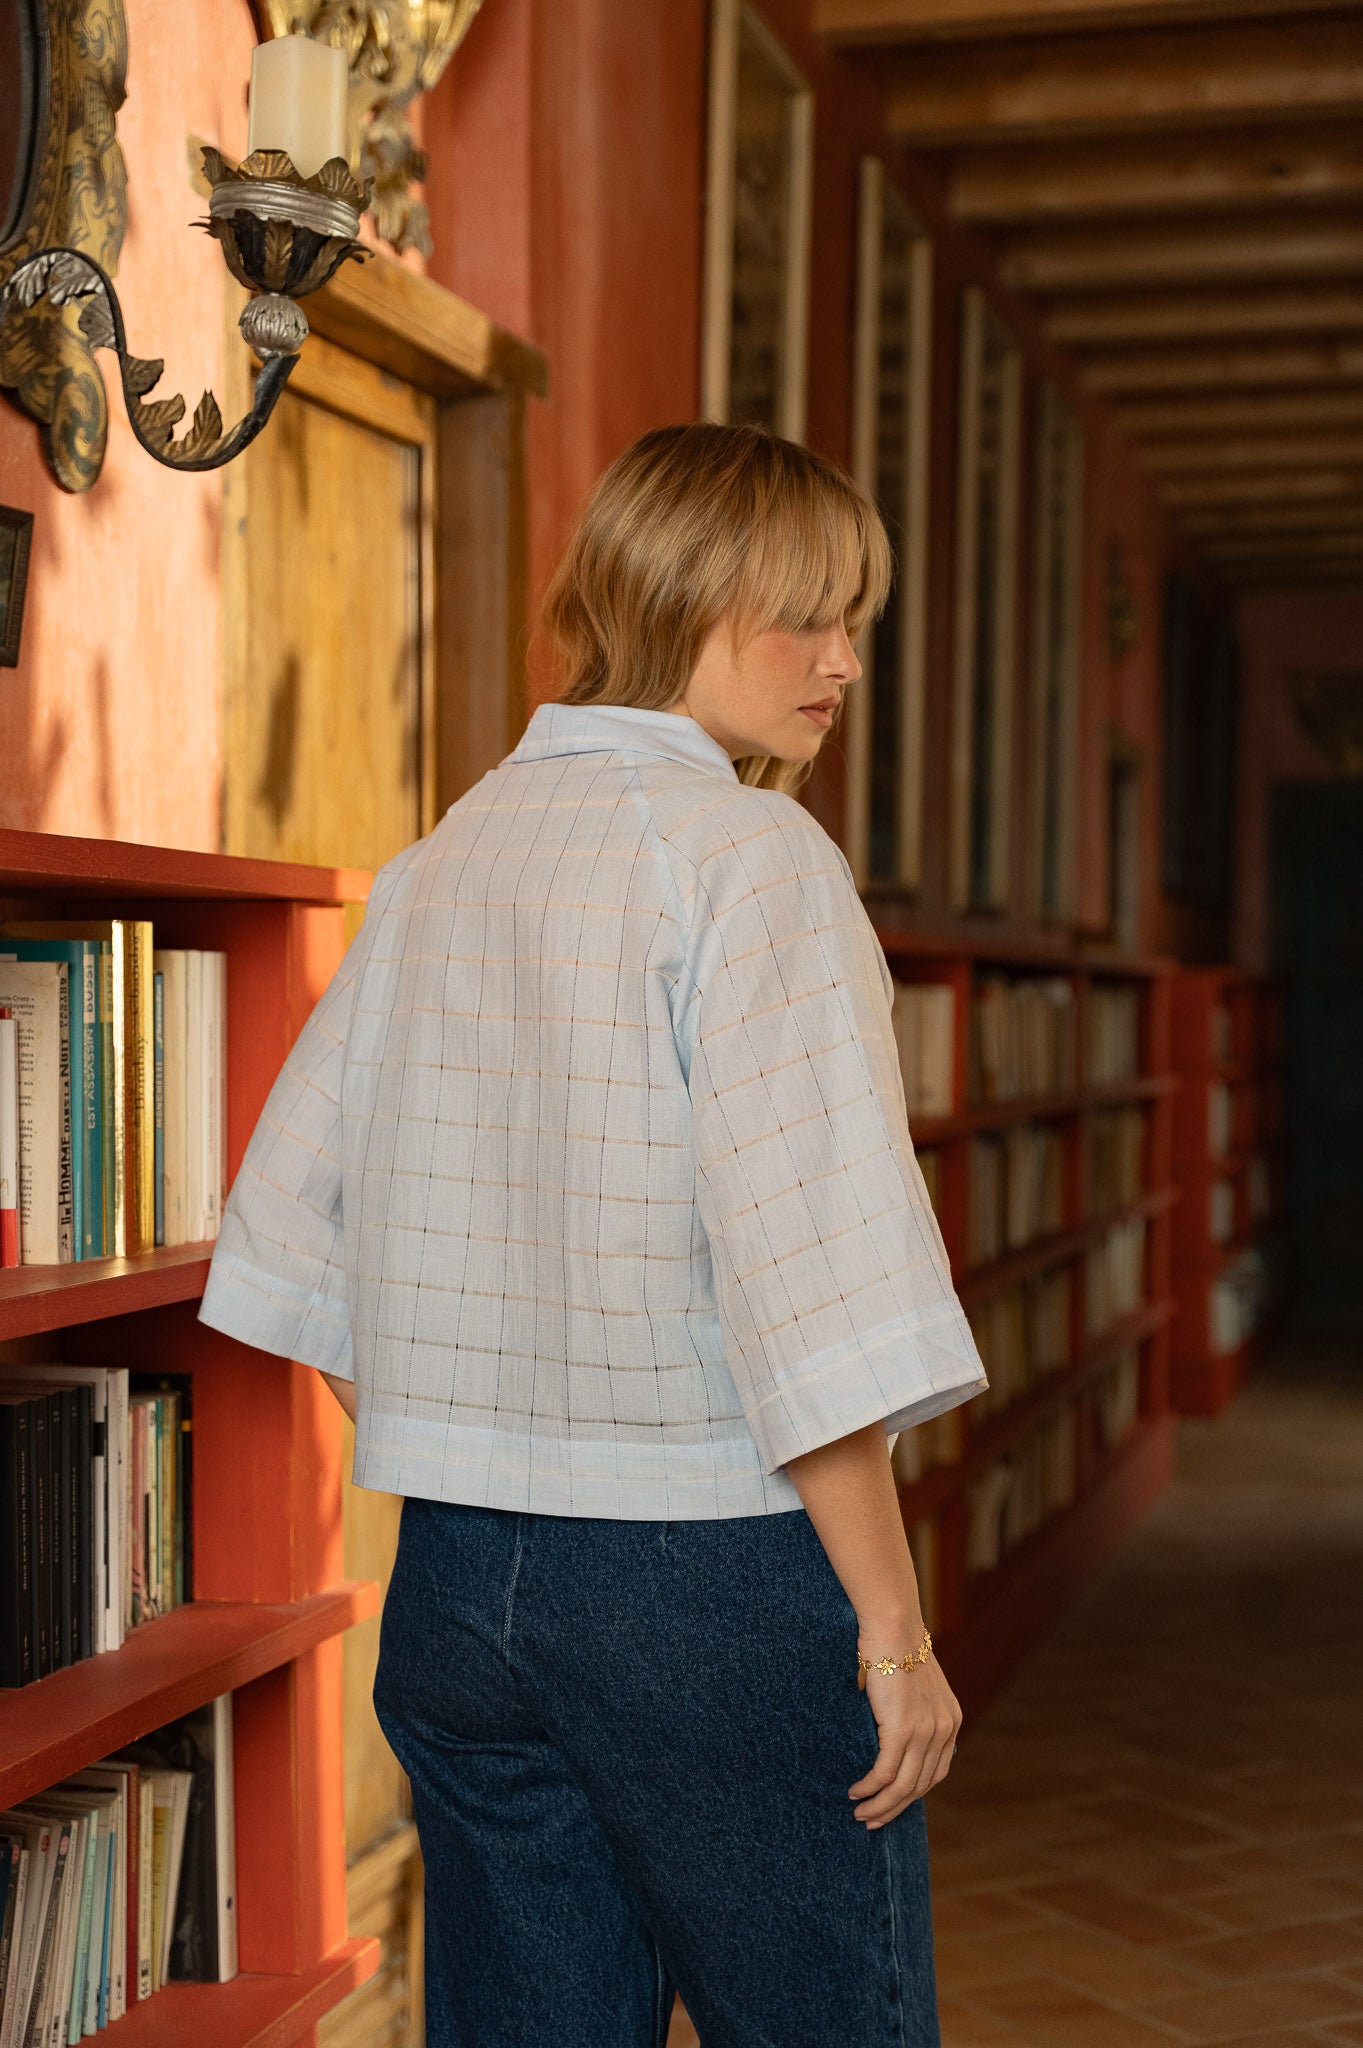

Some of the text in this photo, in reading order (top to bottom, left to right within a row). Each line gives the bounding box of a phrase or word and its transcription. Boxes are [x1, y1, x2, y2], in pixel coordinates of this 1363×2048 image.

[60, 1038, 69, 1078] NUIT
[87, 1028, 95, 1101] ASSASSIN
[59, 1136, 71, 1206] HOMME
